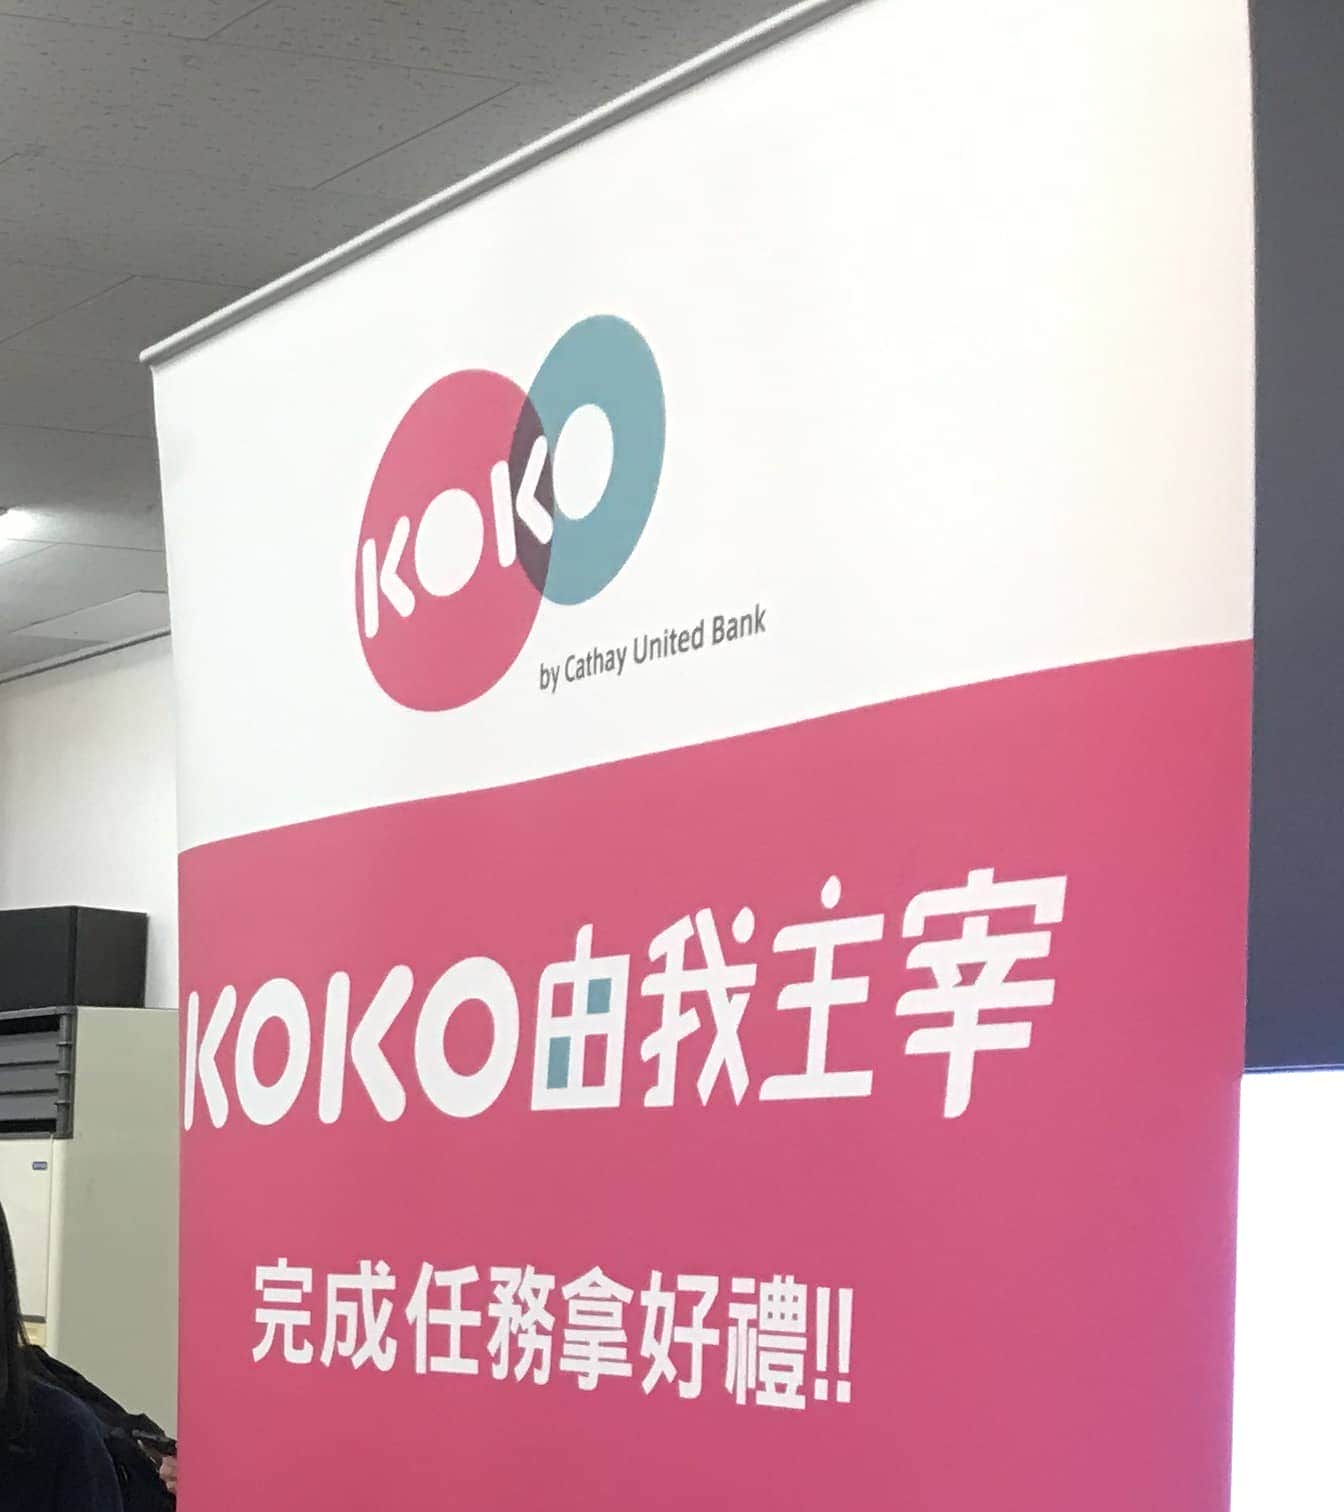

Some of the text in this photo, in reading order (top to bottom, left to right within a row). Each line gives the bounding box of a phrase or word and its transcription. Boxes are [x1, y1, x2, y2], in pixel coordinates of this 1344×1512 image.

[362, 403, 614, 639] KOKO
[538, 604, 767, 694] by Cathay United Bank
[184, 867, 1068, 1132] KOKO由我主宰
[252, 1257, 854, 1410] 完成任務拿好禮!!
